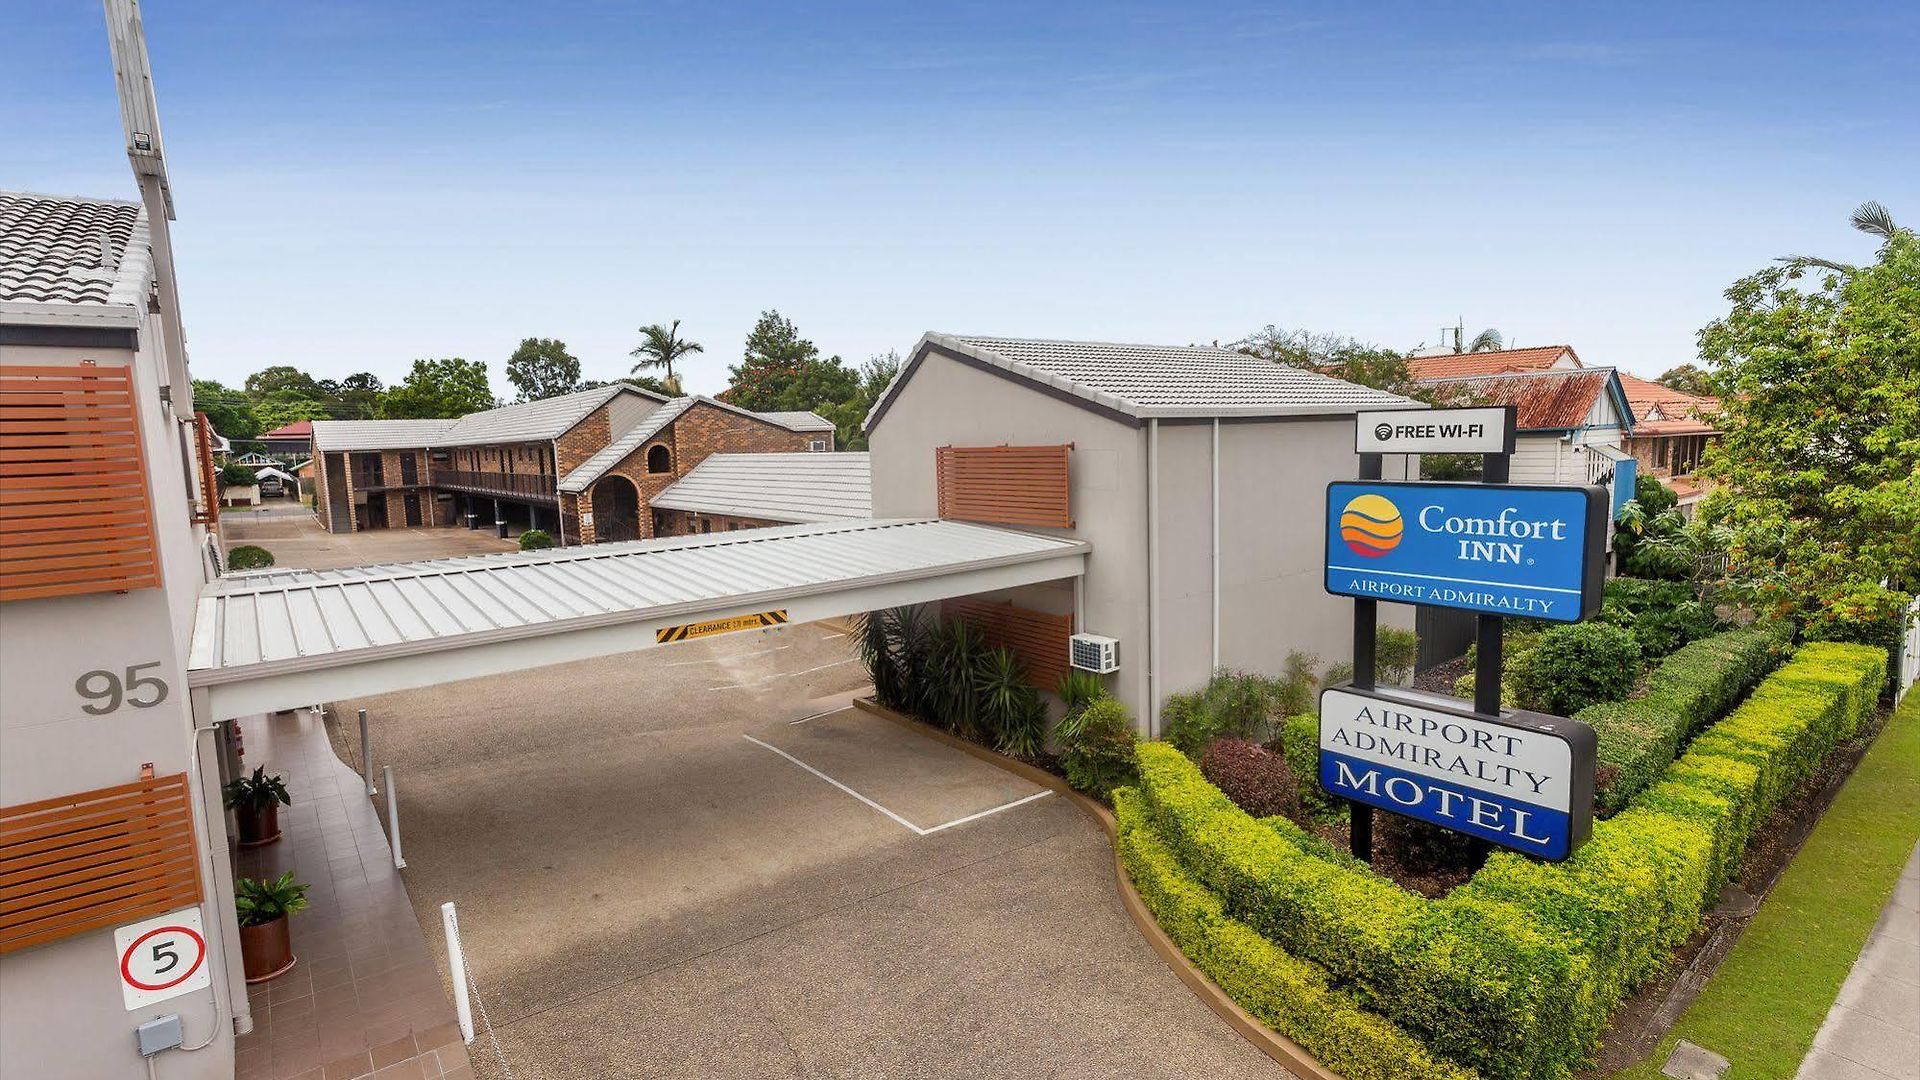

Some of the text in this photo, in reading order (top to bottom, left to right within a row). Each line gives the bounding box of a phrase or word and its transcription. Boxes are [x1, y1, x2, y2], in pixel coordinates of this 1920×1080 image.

[1395, 424, 1484, 439] FREE WI-FI
[1419, 505, 1566, 541] Comfort
[1458, 540, 1523, 565] INN
[1349, 579, 1553, 613] AIRPORT ADMIRALTY
[689, 622, 731, 635] CLEARANCE
[75, 660, 169, 715] 95
[1354, 706, 1523, 756] AIRPORT
[1331, 727, 1552, 794] ADMIRALTY
[1335, 761, 1551, 844] MOTEL
[152, 940, 179, 975] 5
